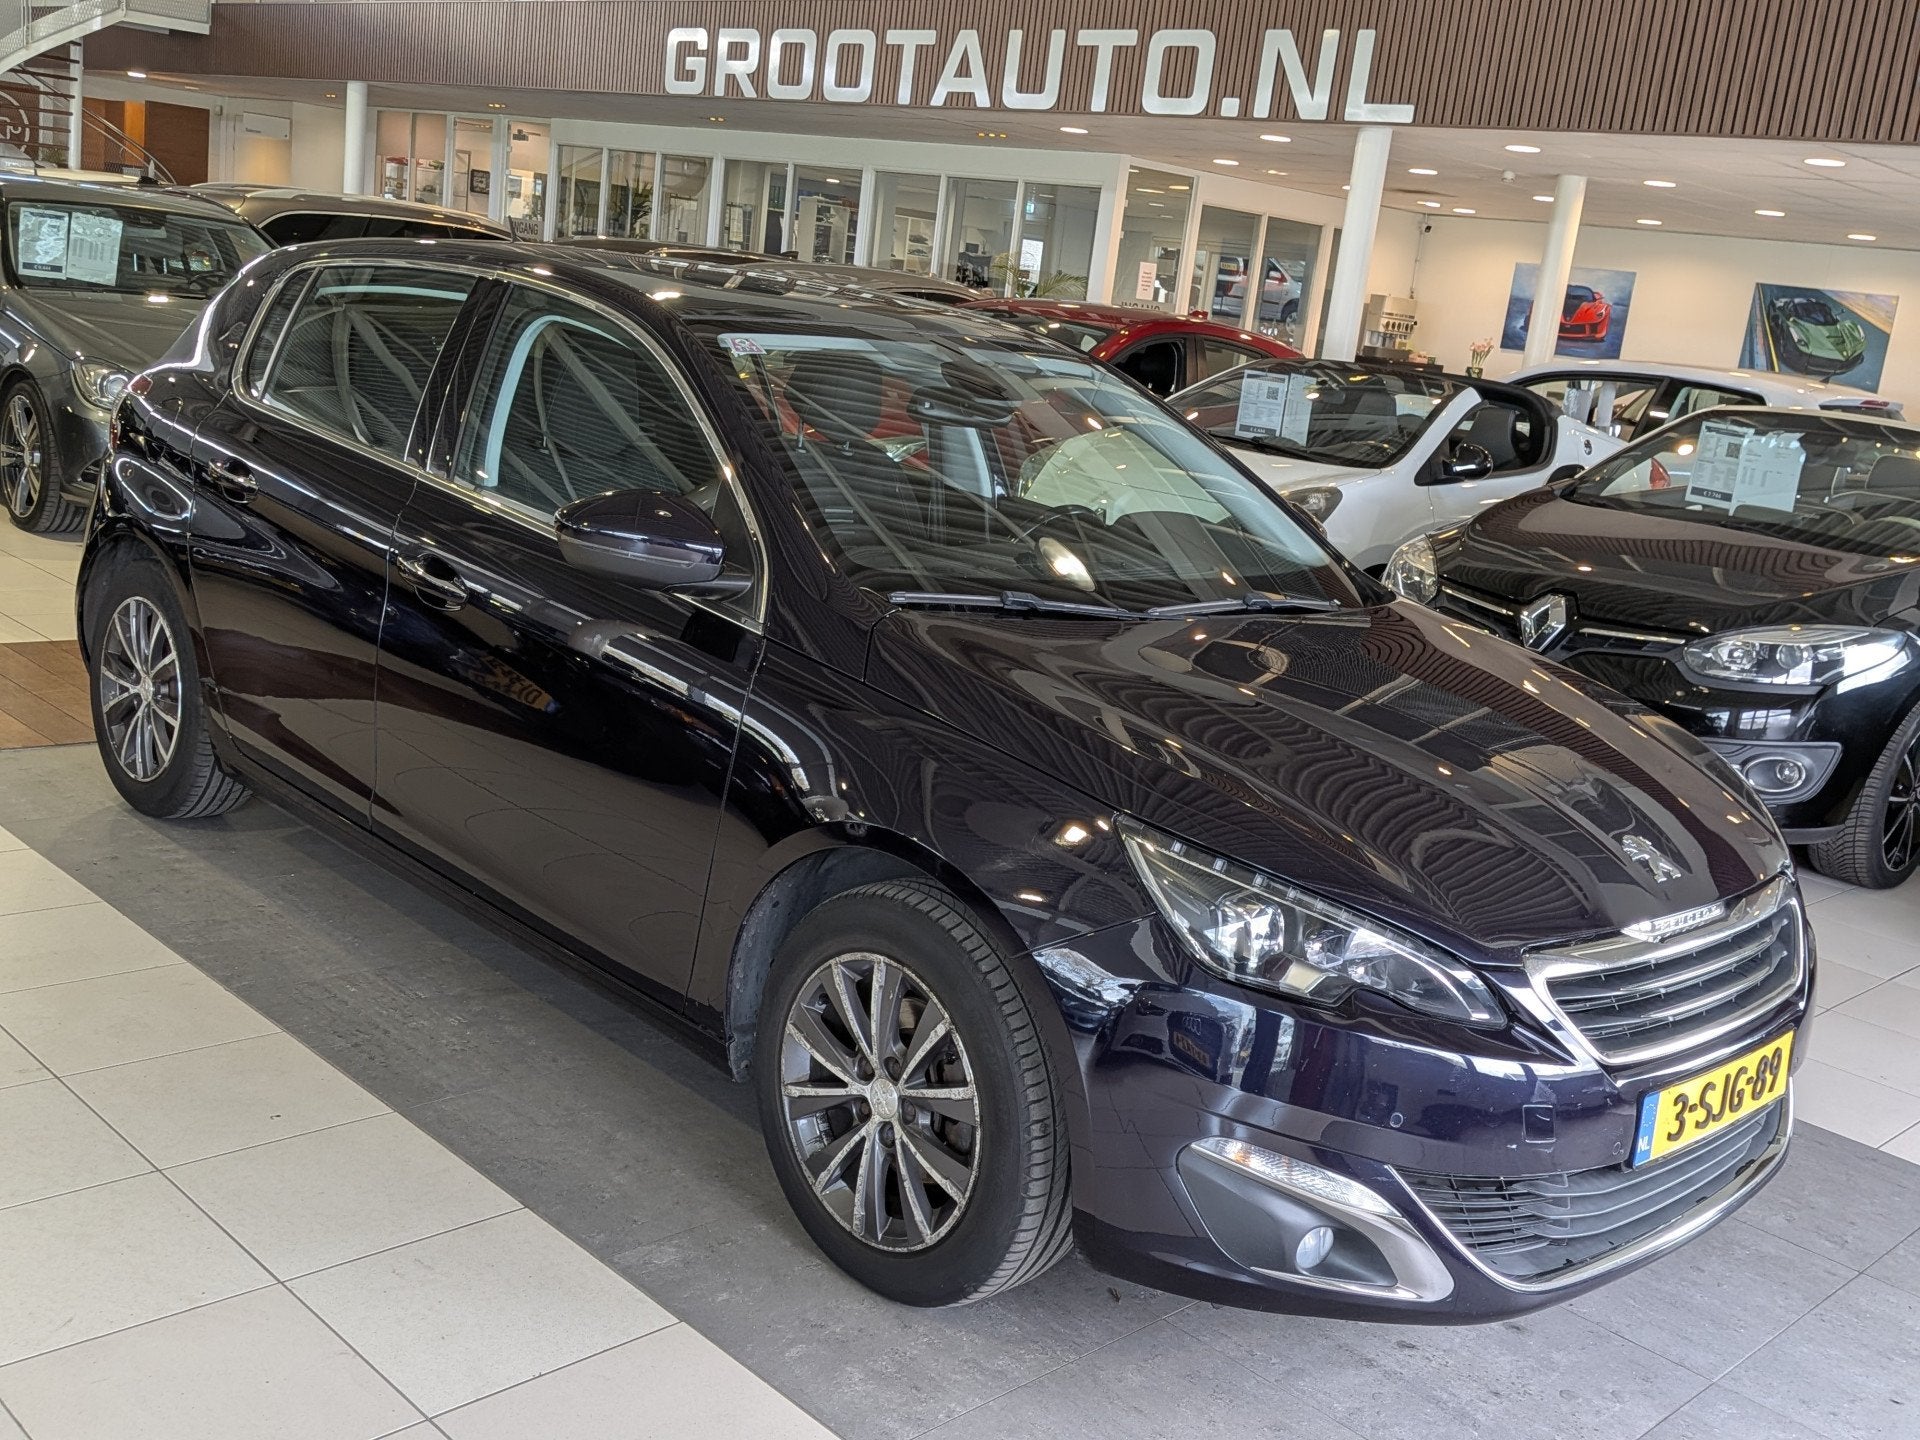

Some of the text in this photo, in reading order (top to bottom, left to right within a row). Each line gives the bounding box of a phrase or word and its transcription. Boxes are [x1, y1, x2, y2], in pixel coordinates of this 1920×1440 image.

[663, 27, 1416, 124] GROOTAUTO.NL
[513, 220, 539, 236] NGANG
[1667, 1047, 1782, 1142] 3-SJG-89
[1637, 1135, 1650, 1153] NL
